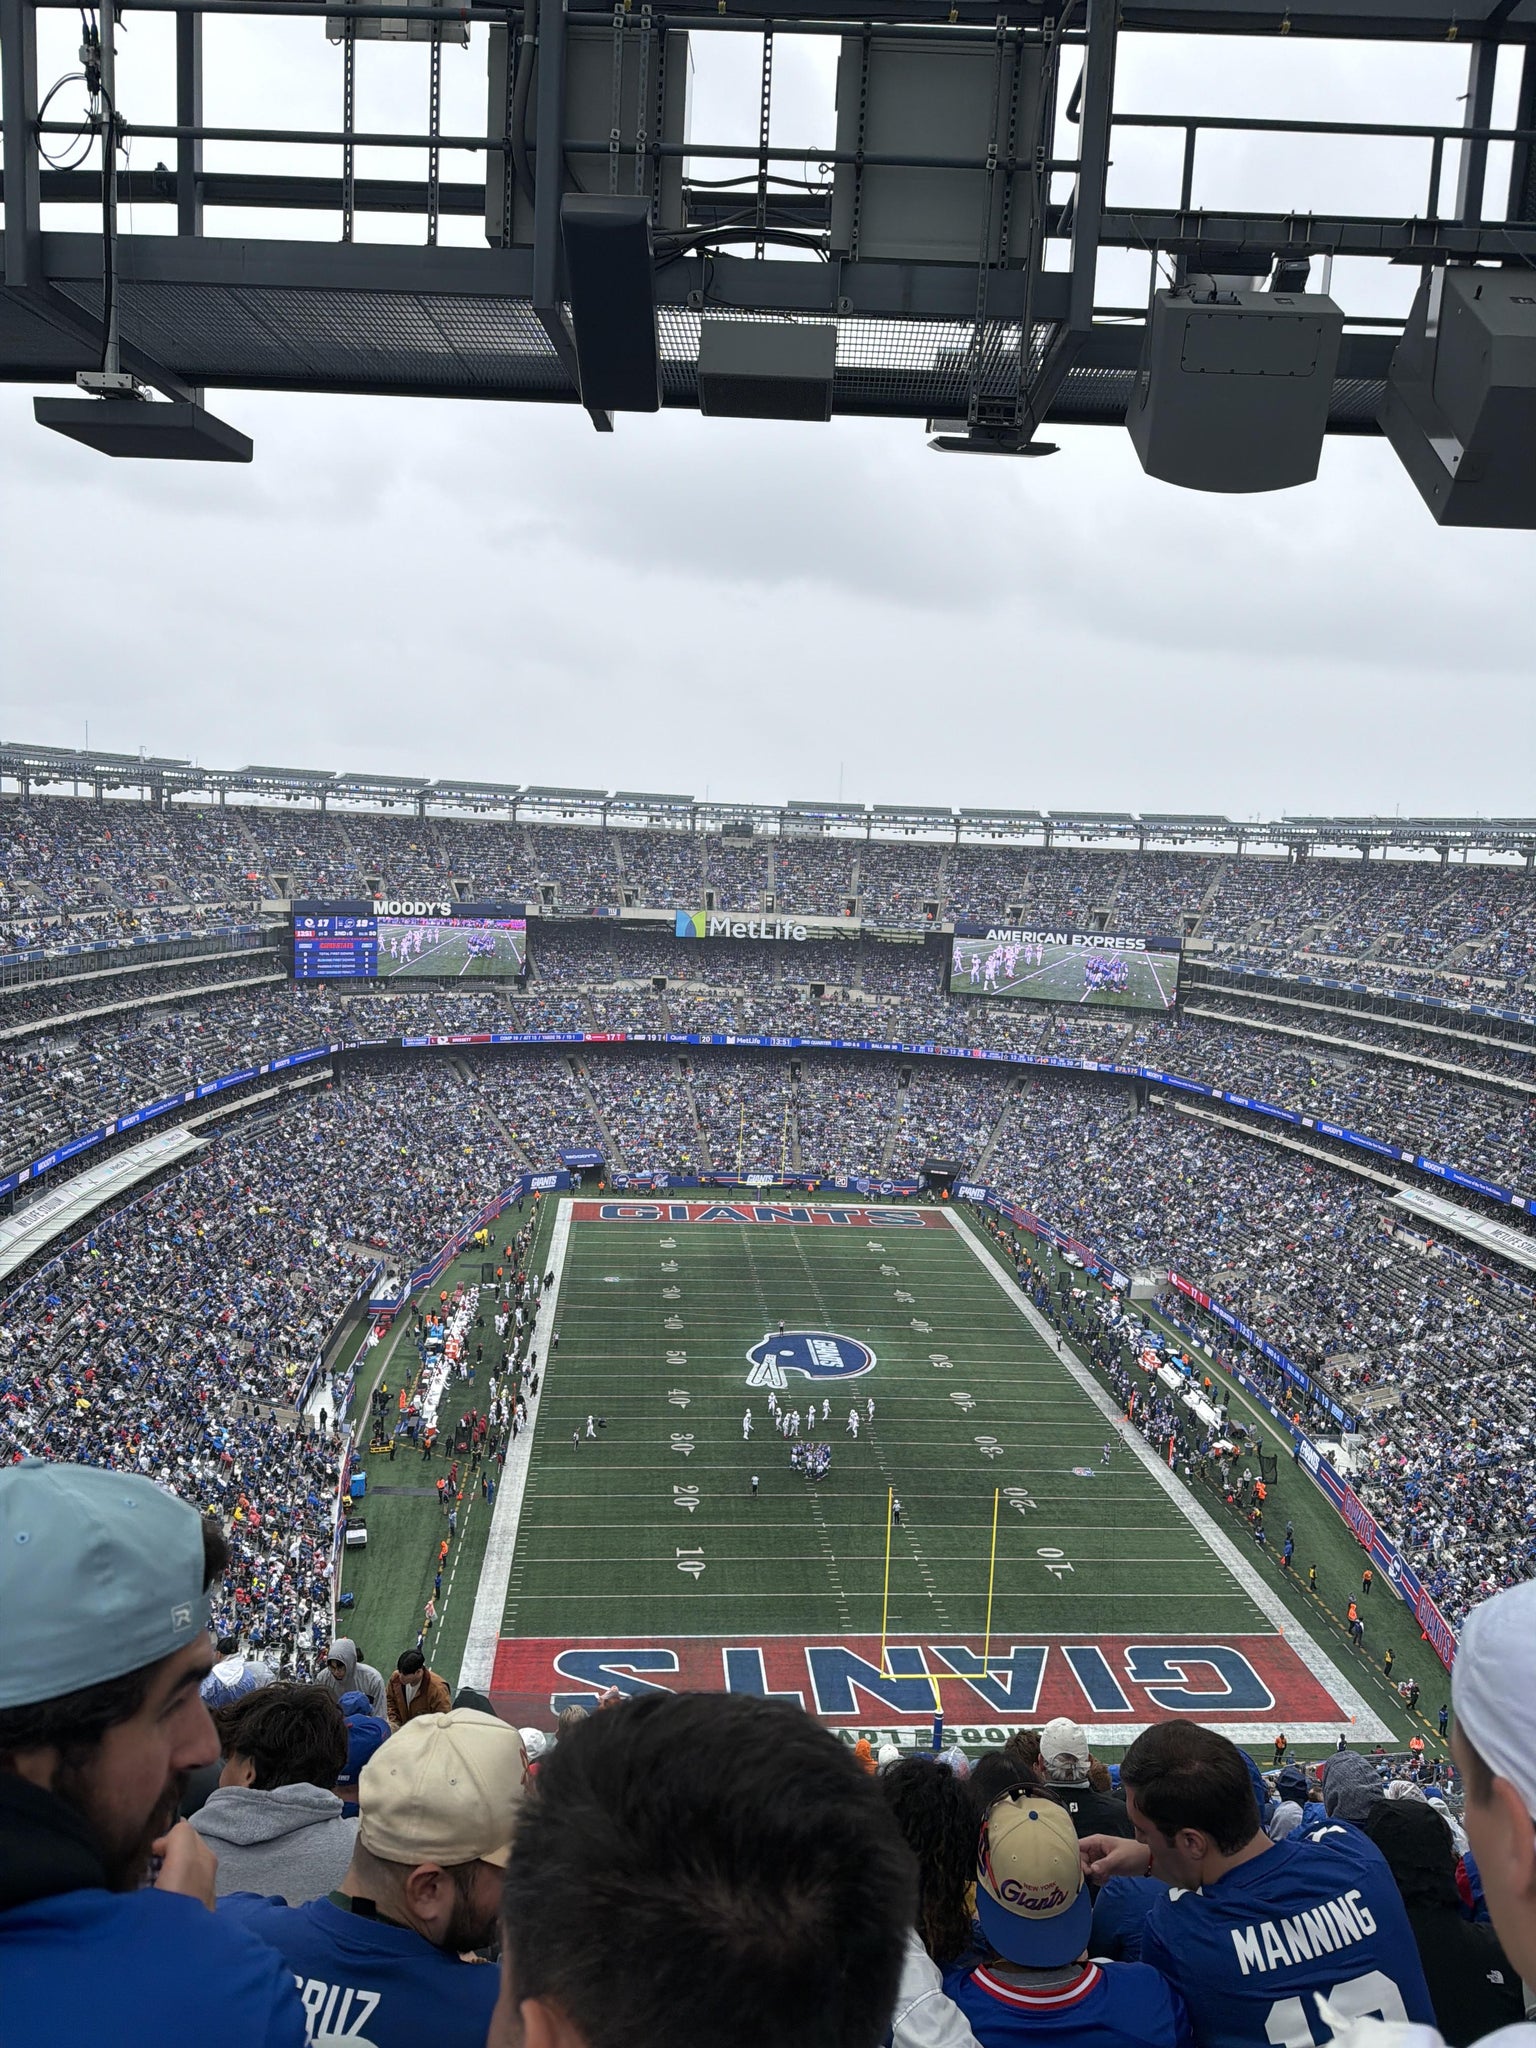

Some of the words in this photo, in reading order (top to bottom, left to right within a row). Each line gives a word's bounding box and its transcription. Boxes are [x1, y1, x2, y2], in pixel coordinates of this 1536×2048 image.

[373, 901, 451, 916] MOODY'S
[710, 917, 807, 941] MetLife
[986, 929, 1068, 945] AMERICAN
[1072, 934, 1146, 950] EXPRESS
[736, 1036, 761, 1045] MetLife
[772, 1038, 790, 1046] 13:51
[1321, 1123, 1343, 1137] MOODY'S
[37, 1155, 56, 1172] MOODY'S
[1423, 1160, 1446, 1175] MOODY'S
[531, 1175, 558, 1188] GIANTS
[747, 1174, 774, 1183] GIANTS
[836, 1177, 845, 1186] 20
[958, 1186, 987, 1199] GIANTS
[1415, 1195, 1434, 1206] MetLife
[15, 1208, 45, 1228] METLIFE
[600, 1203, 925, 1227] GIANTS
[1490, 1229, 1522, 1246] METLIFE
[662, 1288, 681, 1299] 30
[1191, 1287, 1198, 1299] 17
[910, 1320, 933, 1333] 40
[1240, 1322, 1253, 1341] 13:51
[666, 1350, 687, 1364] 50
[812, 1339, 844, 1368] GIANTS
[928, 1354, 954, 1368] 50
[668, 1388, 691, 1404] 40
[950, 1392, 977, 1408] 40
[1321, 1394, 1329, 1409] 19
[670, 1433, 695, 1451] 30
[974, 1436, 1004, 1455] 30
[1300, 1440, 1320, 1471] GIANTS
[673, 1485, 700, 1507] 20
[1003, 1487, 1038, 1508] 20
[1345, 1491, 1374, 1547] GIANTS
[676, 1547, 706, 1572] 10
[1036, 1547, 1075, 1572] 10
[1419, 1596, 1451, 1664] GIANTS
[551, 1645, 1277, 1715] GIANTS
[838, 1729, 901, 1744] LOV
[1070, 1802, 1079, 1813] FJ
[1023, 1882, 1039, 1892] NEW
[1040, 1880, 1057, 1892] YORK
[1000, 1878, 1069, 1911] Giants
[1231, 1889, 1377, 1976] MANNING
